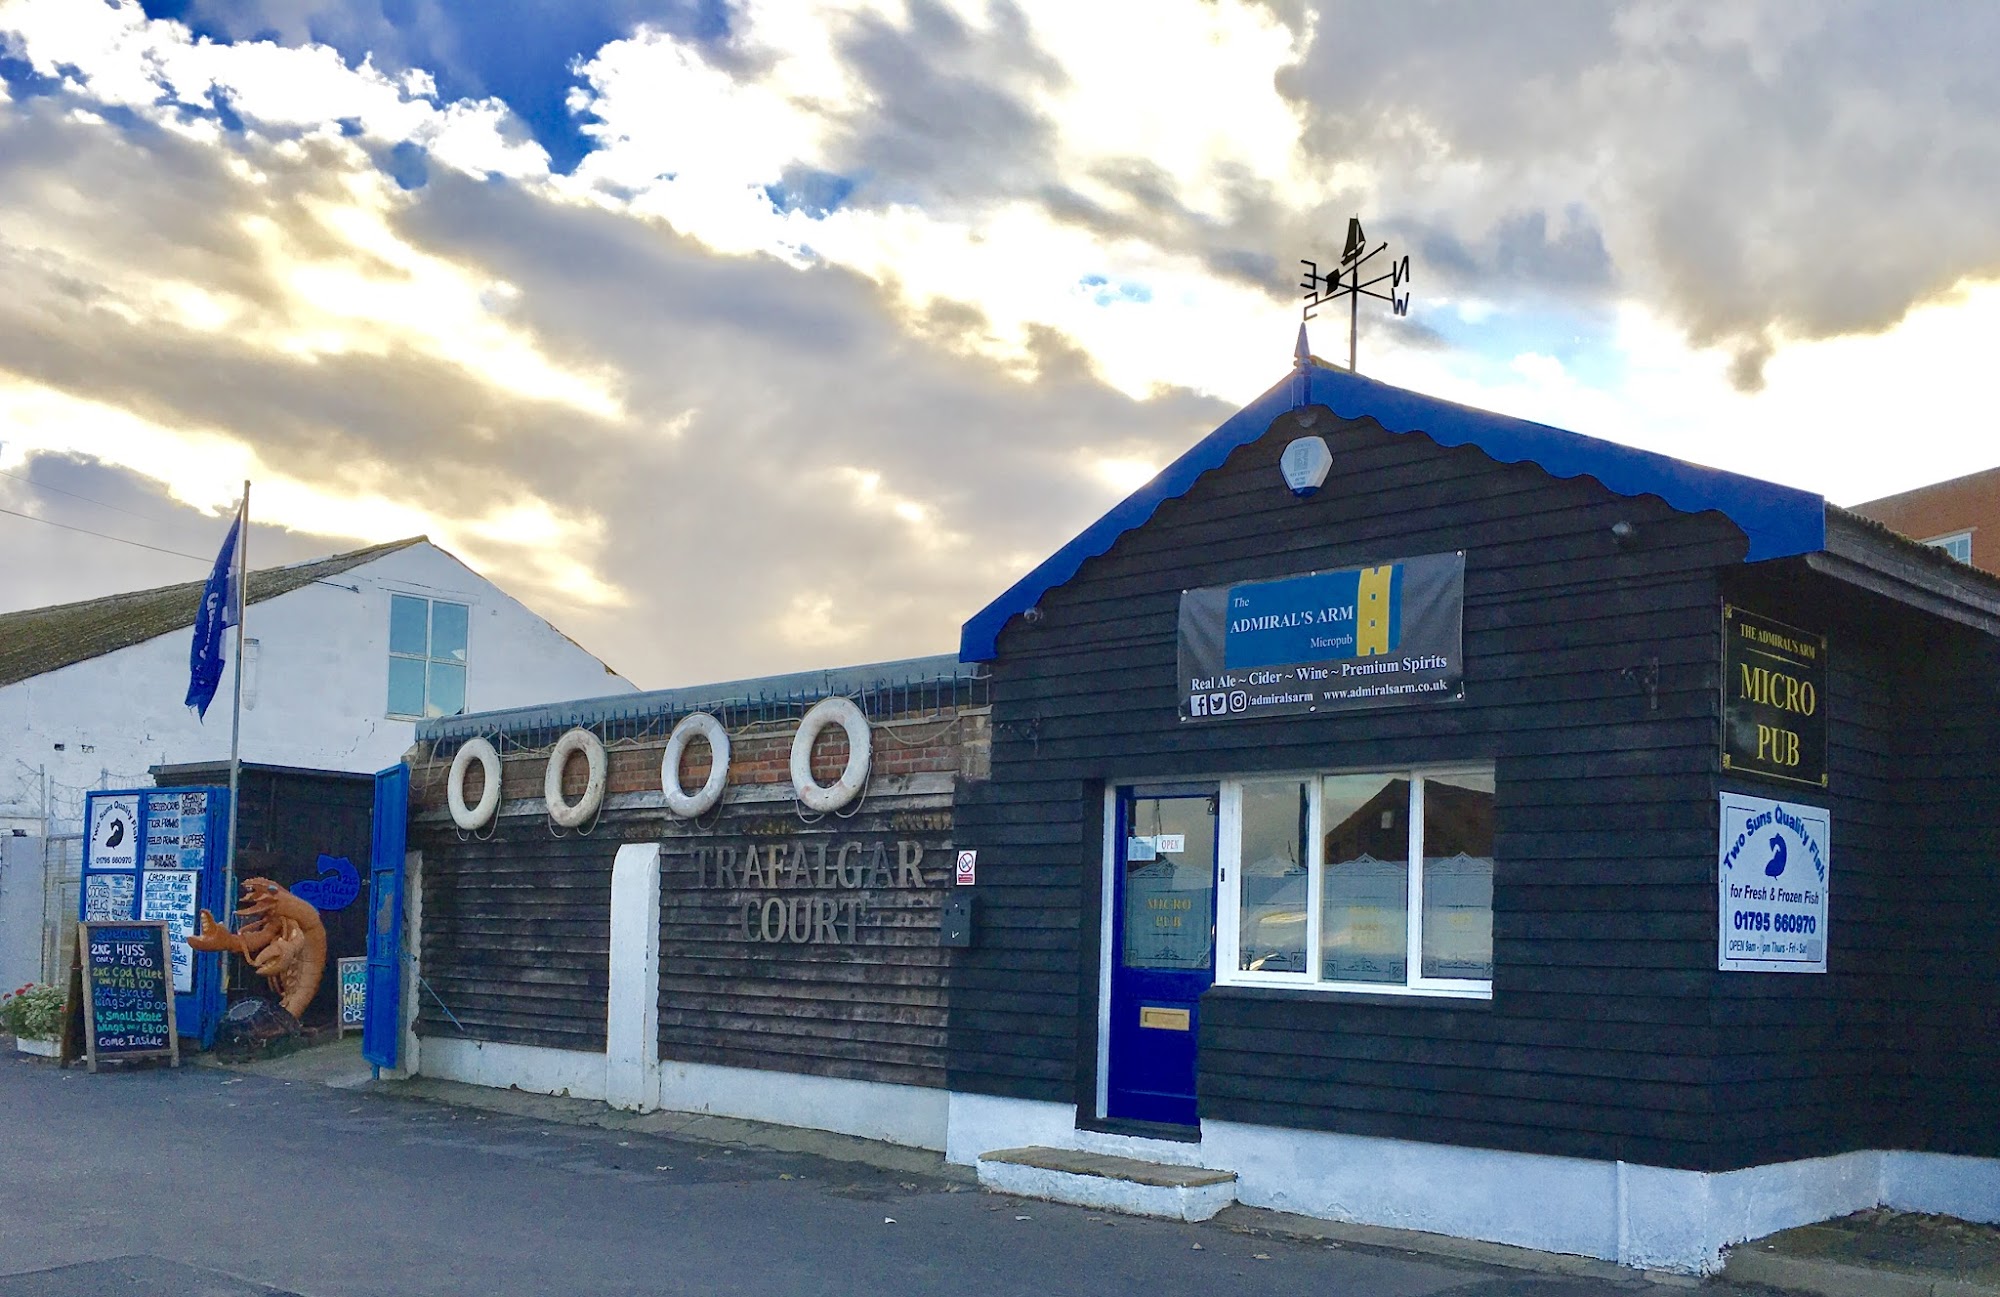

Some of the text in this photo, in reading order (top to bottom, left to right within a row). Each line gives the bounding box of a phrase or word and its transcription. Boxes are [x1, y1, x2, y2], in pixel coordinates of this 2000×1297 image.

[1234, 597, 1249, 608] The
[1230, 605, 1353, 633] ADMIRAL'S ARM
[1310, 633, 1353, 649] Micropub
[1740, 623, 1815, 660] THE ADMIRAL'S ARM
[1191, 676, 1214, 691] Real
[1217, 675, 1236, 689] Ale
[1249, 669, 1282, 686] Cider
[1296, 666, 1328, 681] Wine
[1342, 660, 1399, 677] Premium
[1403, 654, 1447, 673] Spirits
[1248, 679, 1447, 706] /admiralsarm www.admiralsarm.co.uk
[1740, 663, 1816, 716] MICRO
[1756, 724, 1800, 767] PUB
[92, 822, 100, 842] Two
[1723, 804, 1825, 883] Two Suns Quality Fish
[1161, 839, 1179, 850] OPEN
[691, 841, 926, 889] TRAFALGAR
[1730, 884, 1819, 905] for Fresh & Frozen Fish
[741, 896, 867, 944] COURT
[1734, 910, 1816, 934] 01795 660970
[117, 943, 146, 957] HUSS
[1729, 940, 1744, 951] OPEN
[112, 968, 134, 978] Cod
[99, 1034, 164, 1047] Come Inside
